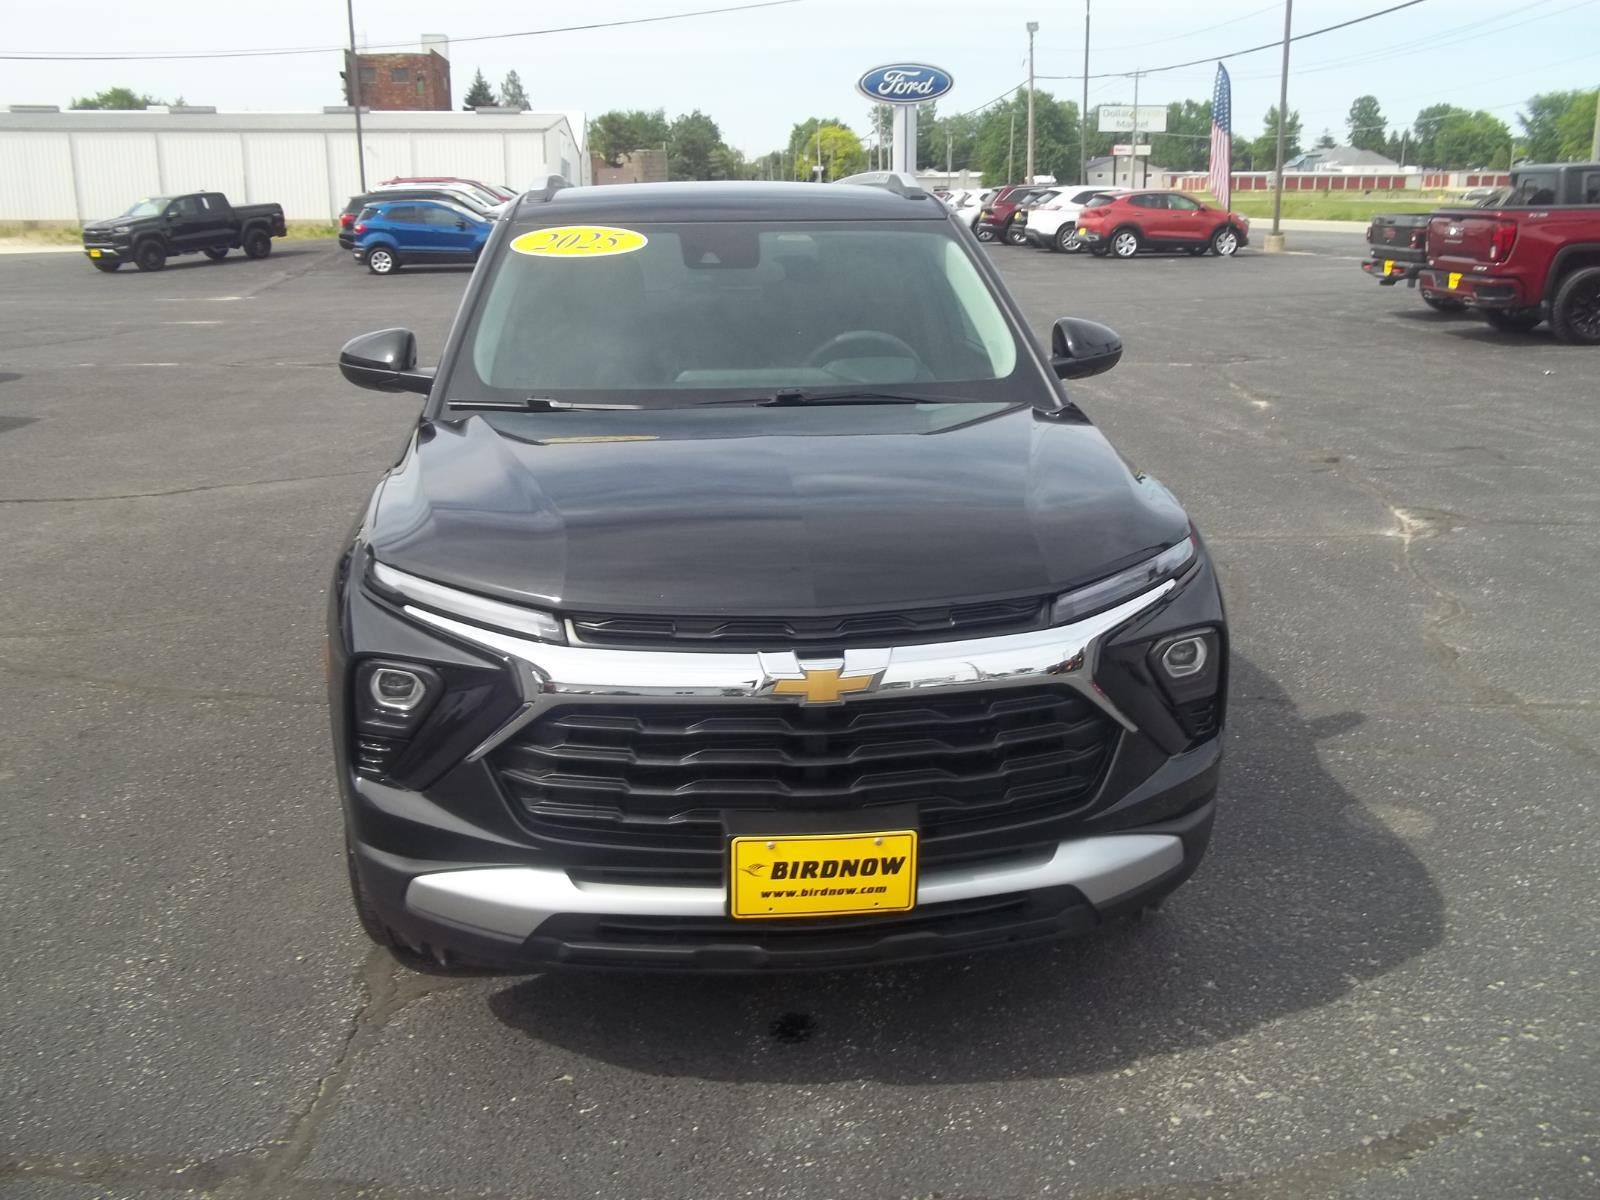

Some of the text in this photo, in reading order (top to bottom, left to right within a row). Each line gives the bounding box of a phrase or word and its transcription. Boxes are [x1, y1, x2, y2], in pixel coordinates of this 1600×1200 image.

[878, 70, 935, 95] Ford
[534, 232, 625, 250] 2025
[770, 856, 906, 880] BIRDNOW
[760, 885, 888, 898] www.birdnow.com
